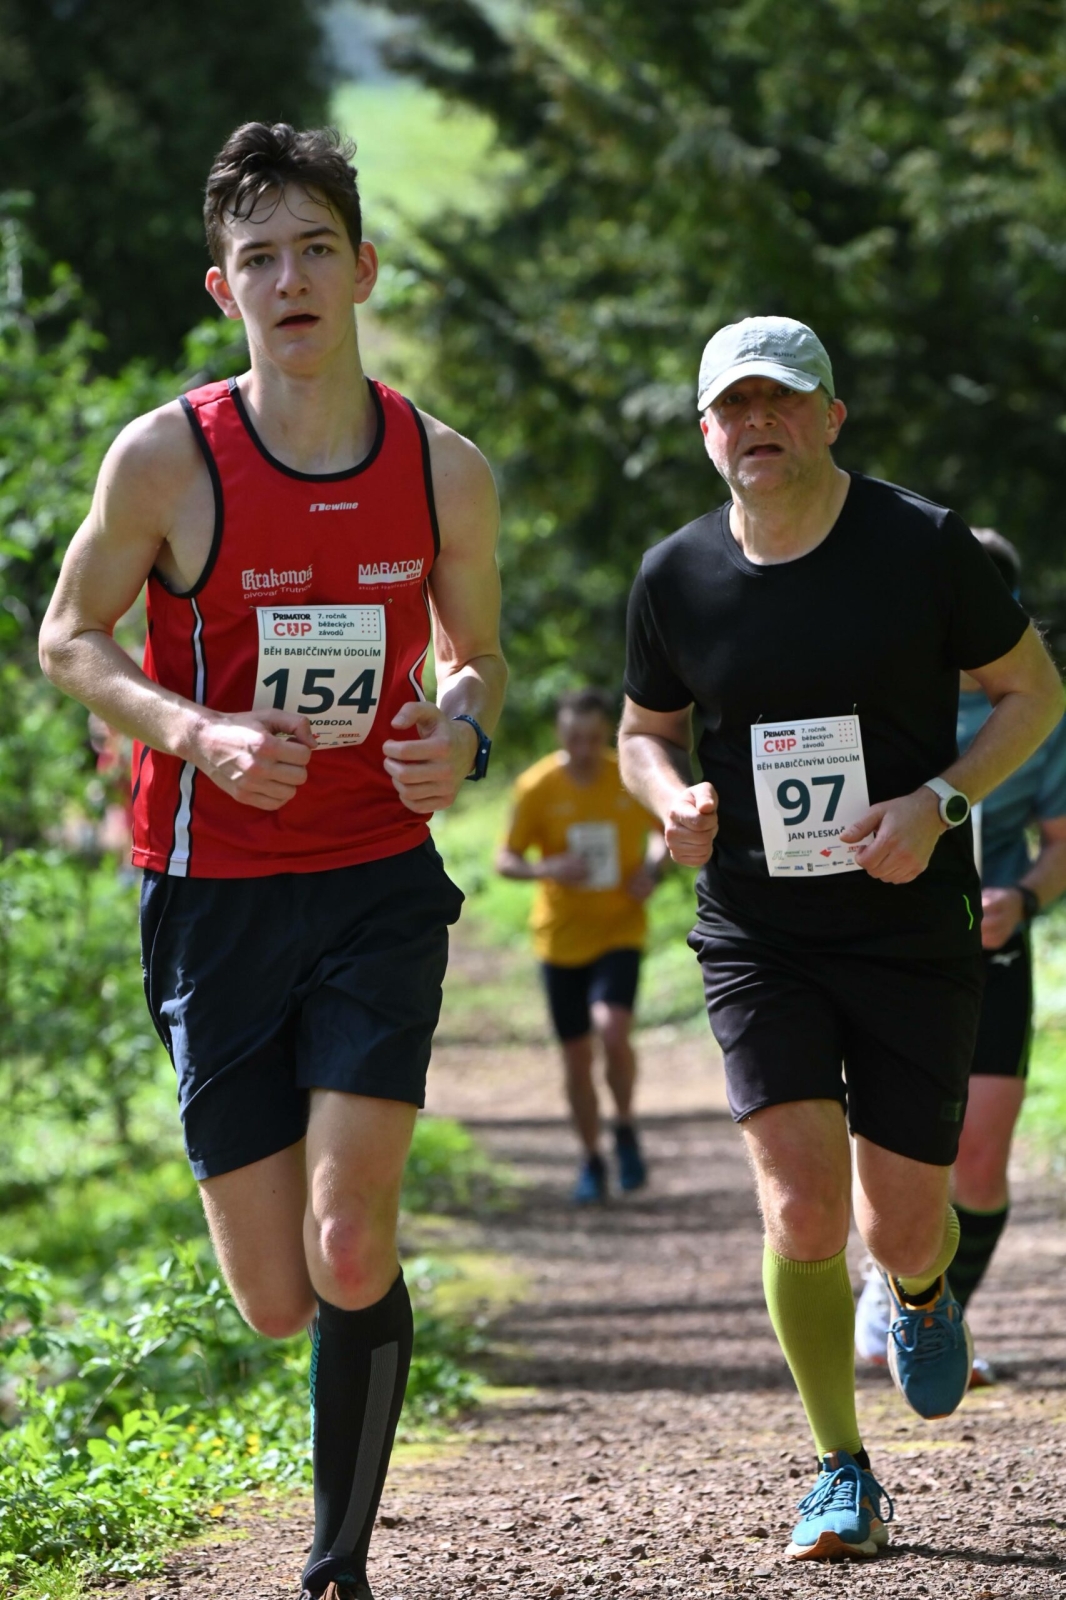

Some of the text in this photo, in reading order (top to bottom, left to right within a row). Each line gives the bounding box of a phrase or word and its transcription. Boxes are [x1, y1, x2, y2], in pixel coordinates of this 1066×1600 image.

[358, 557, 424, 576] MARATON
[243, 583, 312, 600] pivovar Trutnov
[272, 612, 311, 621] PRIMATOR
[273, 622, 312, 637] CUP
[318, 621, 355, 629] běžeckých
[263, 646, 381, 657] BĚH BABIČČINÝM ÚDOLÍM
[262, 668, 377, 715] 154
[763, 729, 796, 739] PRIMATOR
[801, 733, 834, 742] běžeckých
[763, 738, 797, 753] CUP
[802, 741, 825, 749] závodů
[757, 754, 860, 771] BĚH BABIČČINÝM ÚDOLÍM
[777, 774, 845, 826] 97
[788, 832, 805, 842] JAN
